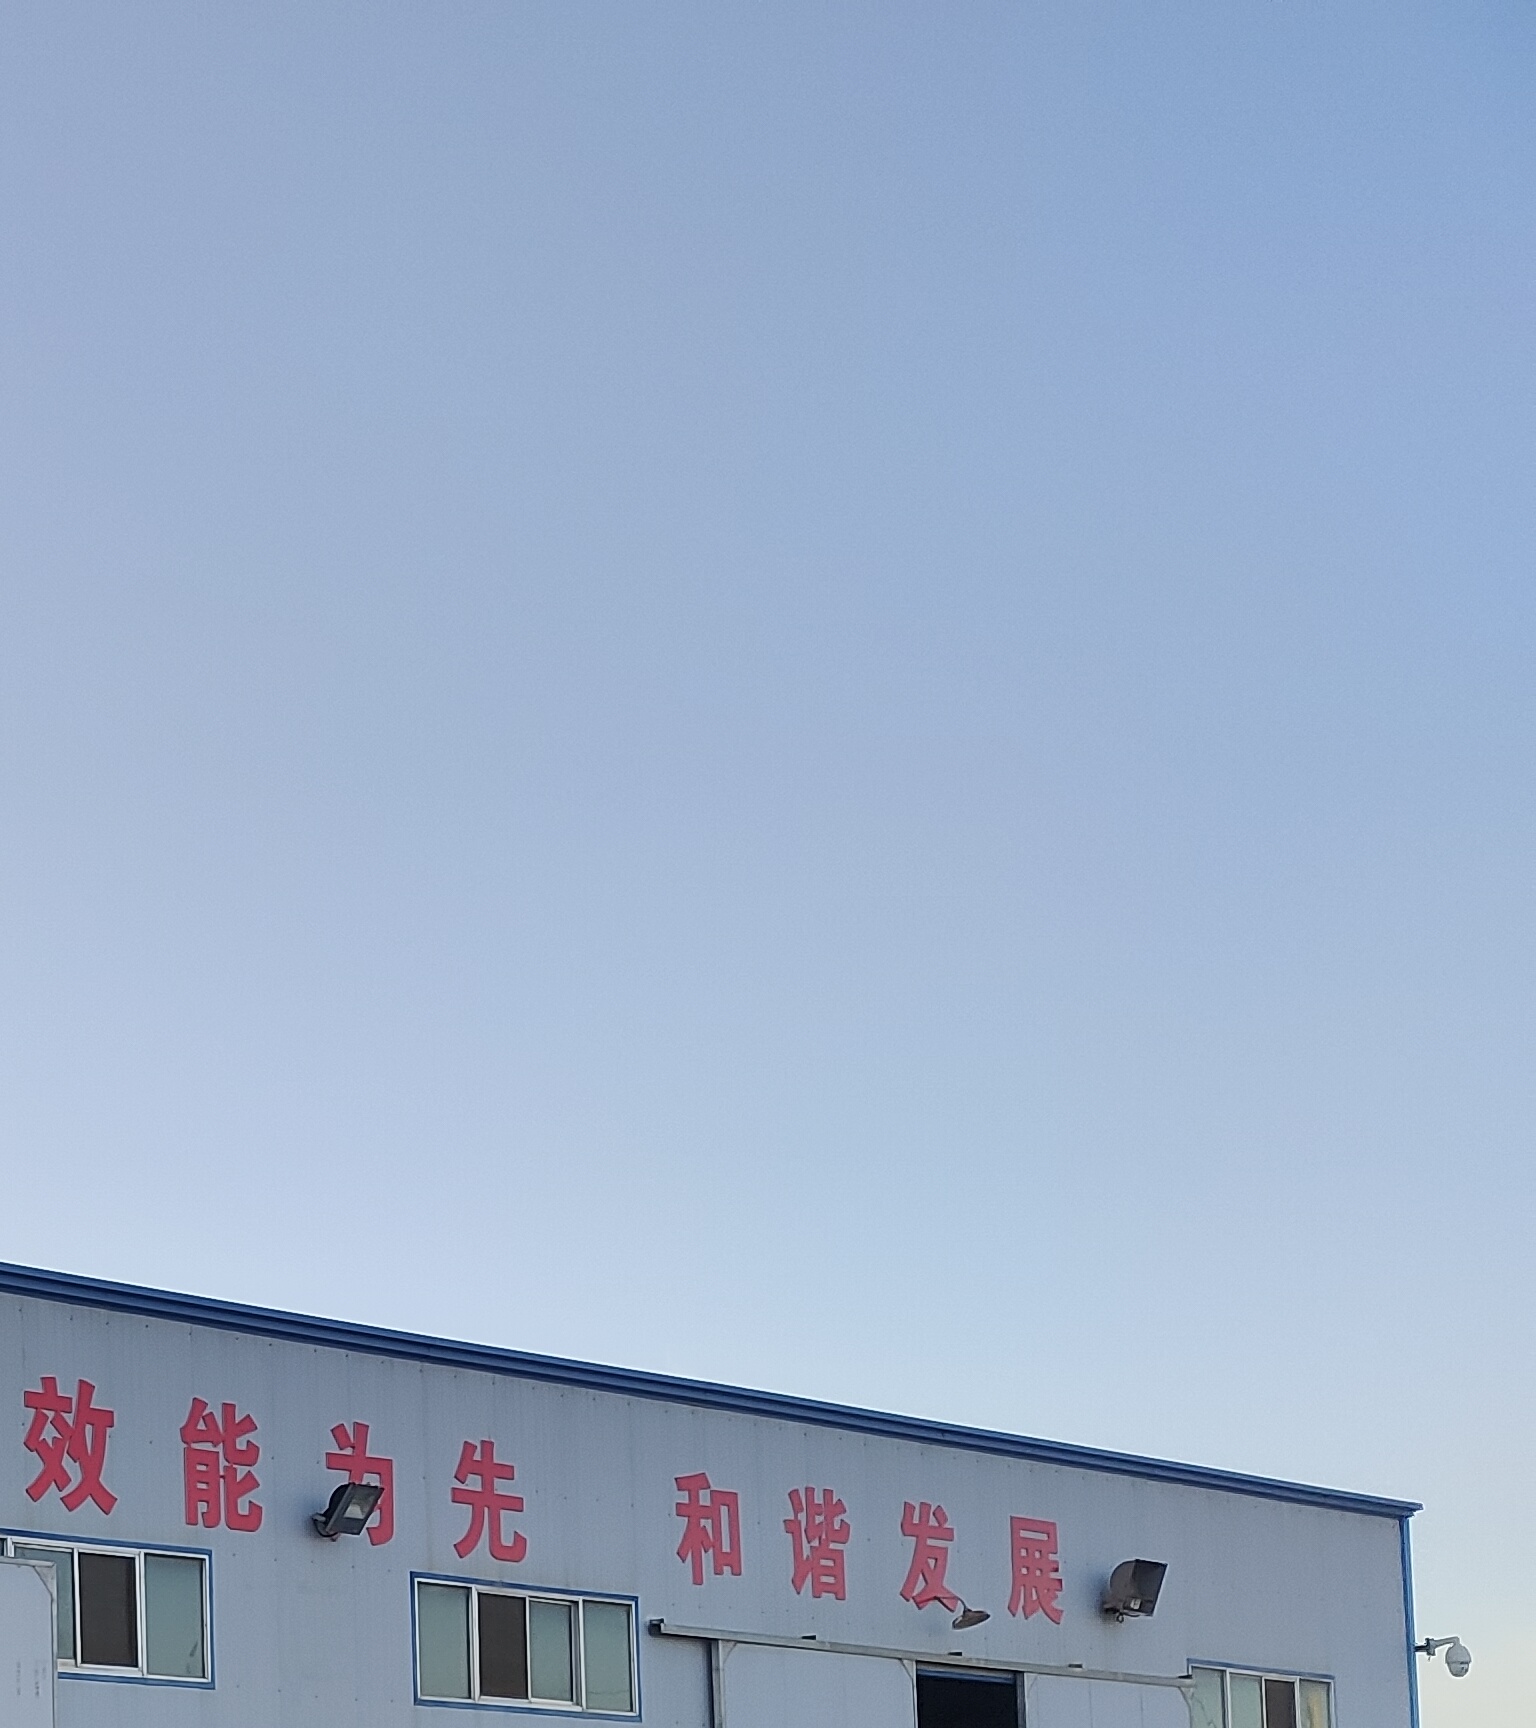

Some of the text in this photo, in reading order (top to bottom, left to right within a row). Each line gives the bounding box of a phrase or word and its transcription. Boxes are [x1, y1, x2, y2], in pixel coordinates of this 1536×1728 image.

[24, 1376, 528, 1563] 效能为先
[676, 1473, 1063, 1624] 和谐发展
